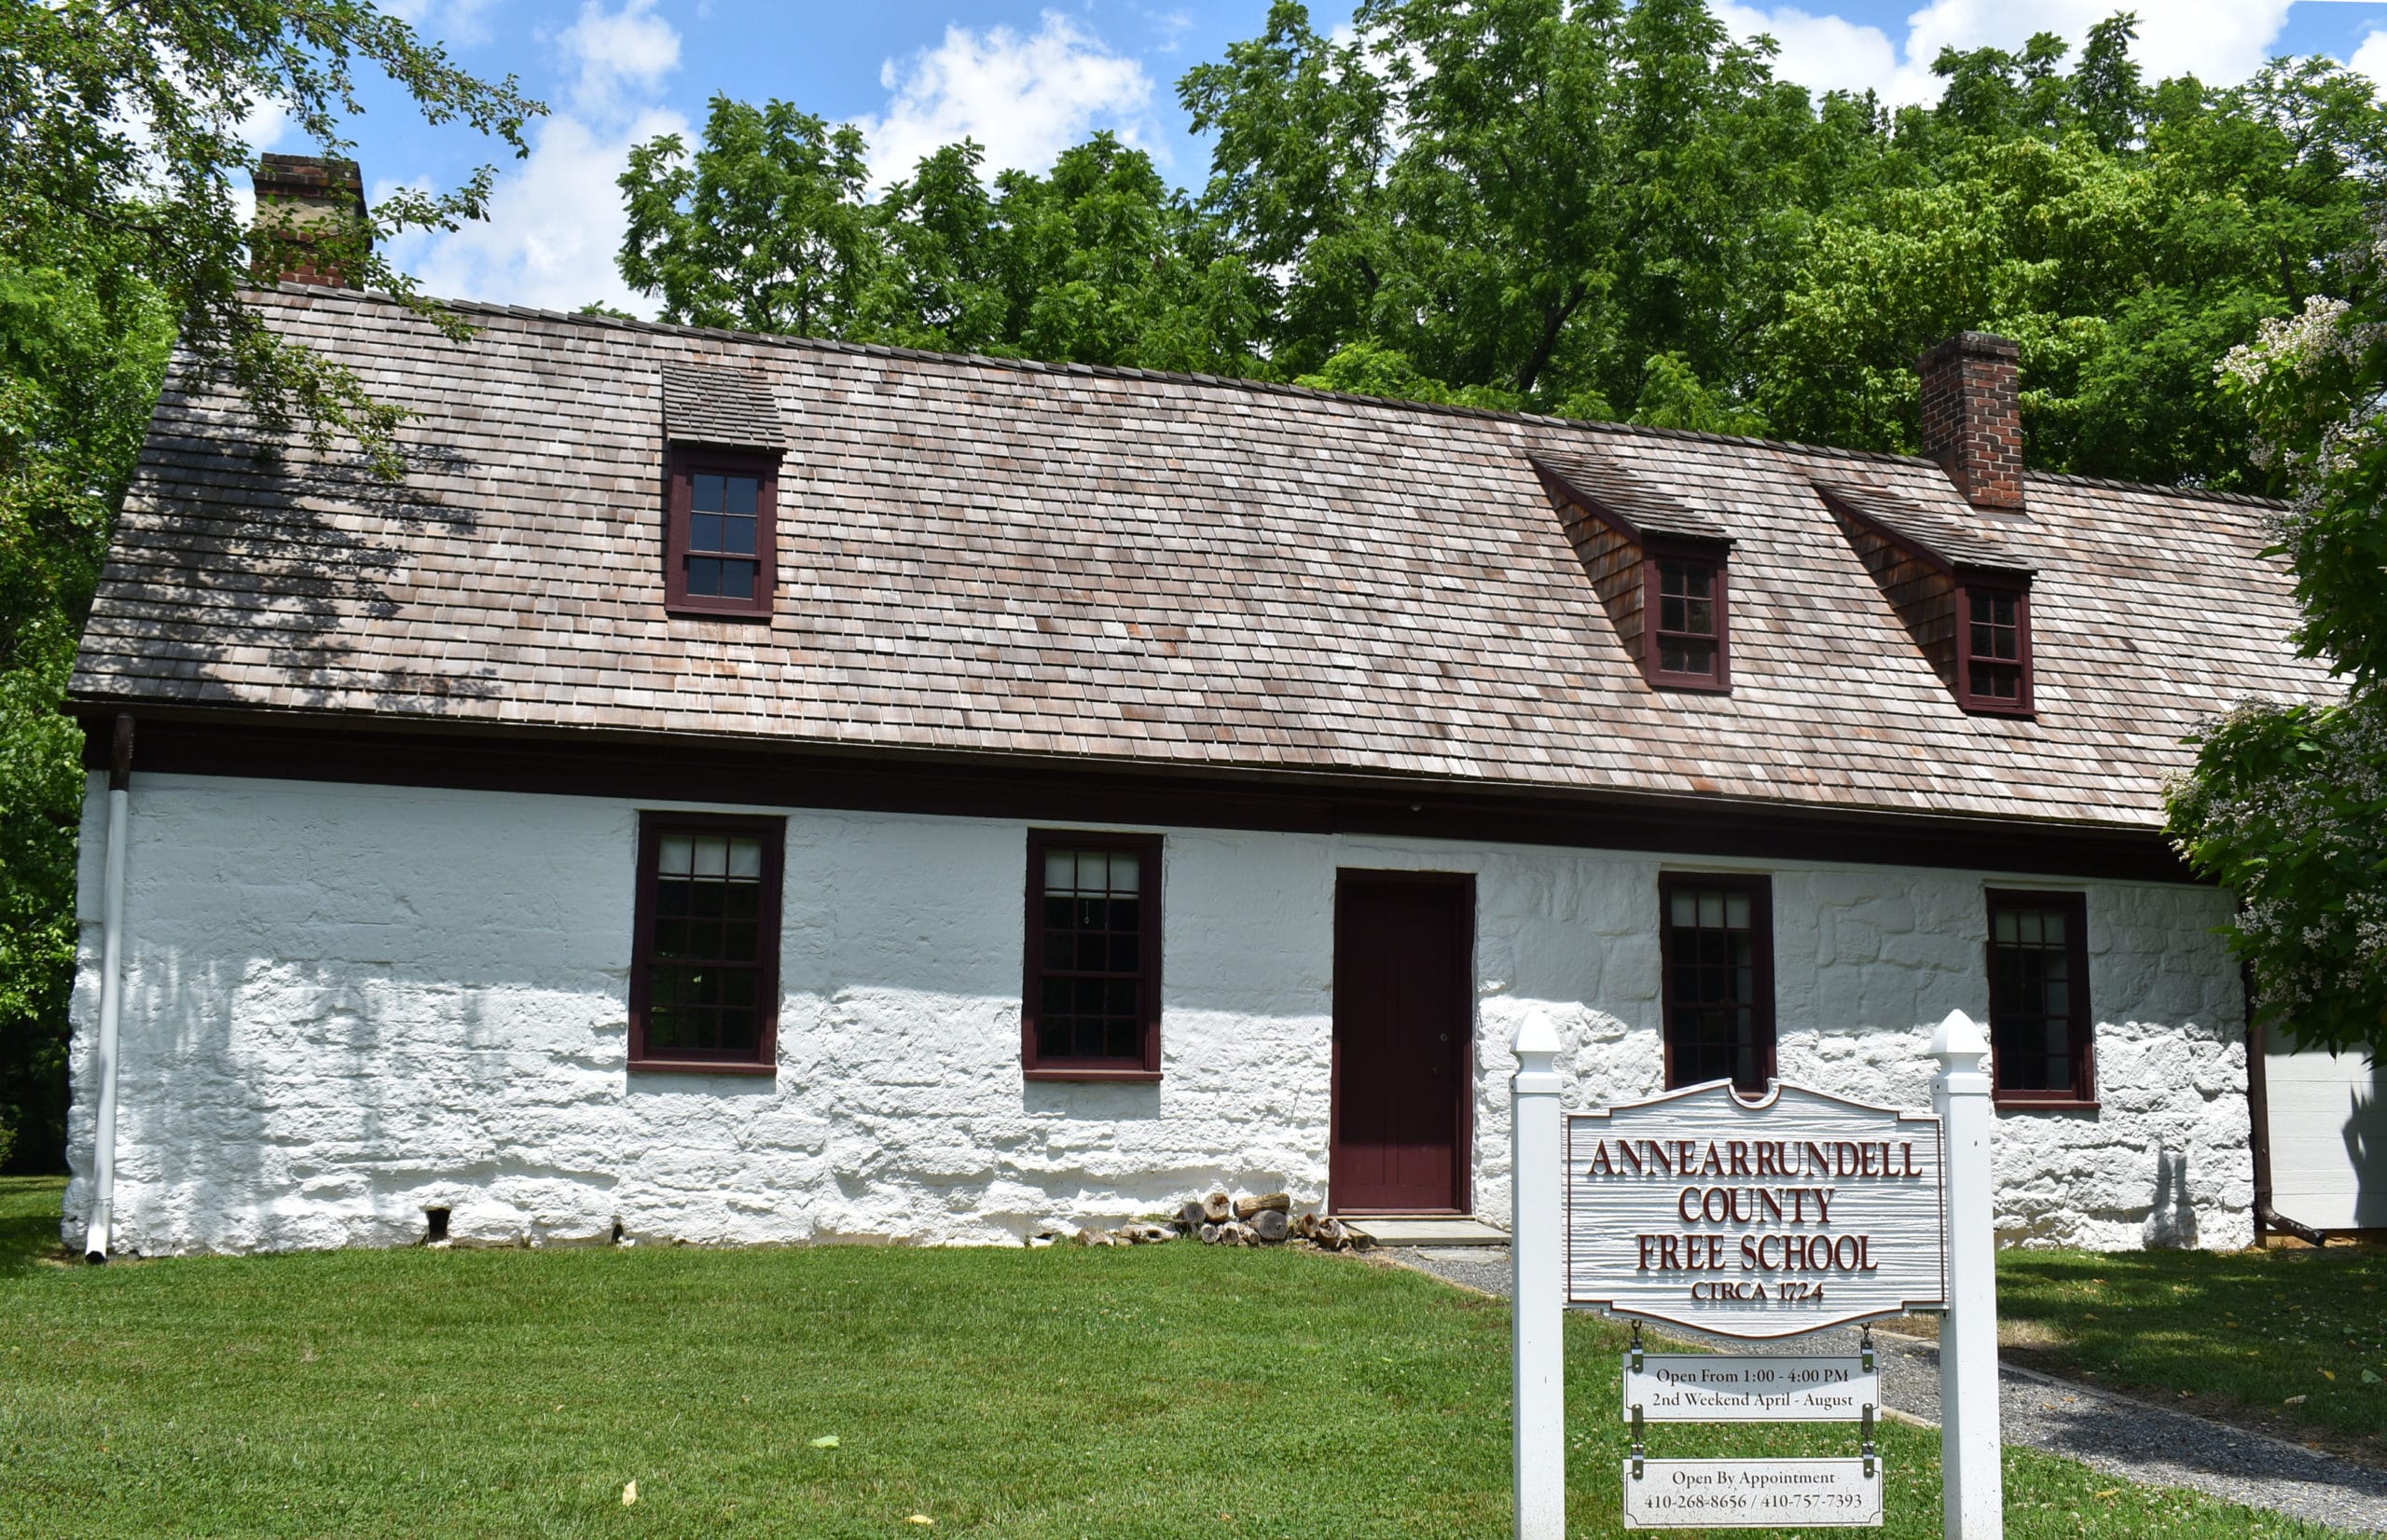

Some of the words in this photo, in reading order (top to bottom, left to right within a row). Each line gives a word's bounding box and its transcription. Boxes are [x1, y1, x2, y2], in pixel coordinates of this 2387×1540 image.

[1588, 1138, 1924, 1176] ANNEARRUNDELL
[1678, 1187, 1835, 1223] COUNTY
[1636, 1234, 1726, 1271] FREE
[1740, 1234, 1878, 1271] SCHOOL
[1691, 1282, 1768, 1300] CIRCA
[1779, 1282, 1824, 1301] 1724
[1656, 1368, 1695, 1384] Open
[1701, 1369, 1739, 1382] From
[1744, 1369, 1775, 1382] 1:00
[1787, 1369, 1819, 1382] 4:00
[1824, 1369, 1849, 1382] PM
[1652, 1393, 1680, 1407] 2nd
[1685, 1392, 1750, 1407] Weekend
[1754, 1393, 1791, 1409] April
[1804, 1393, 1854, 1409] August
[1672, 1472, 1713, 1489] Open
[1718, 1471, 1735, 1488] By
[1739, 1470, 1835, 1489] Appointment
[1644, 1494, 1747, 1509] 410-268-8656
[1761, 1493, 1863, 1509] 410-757-7393
